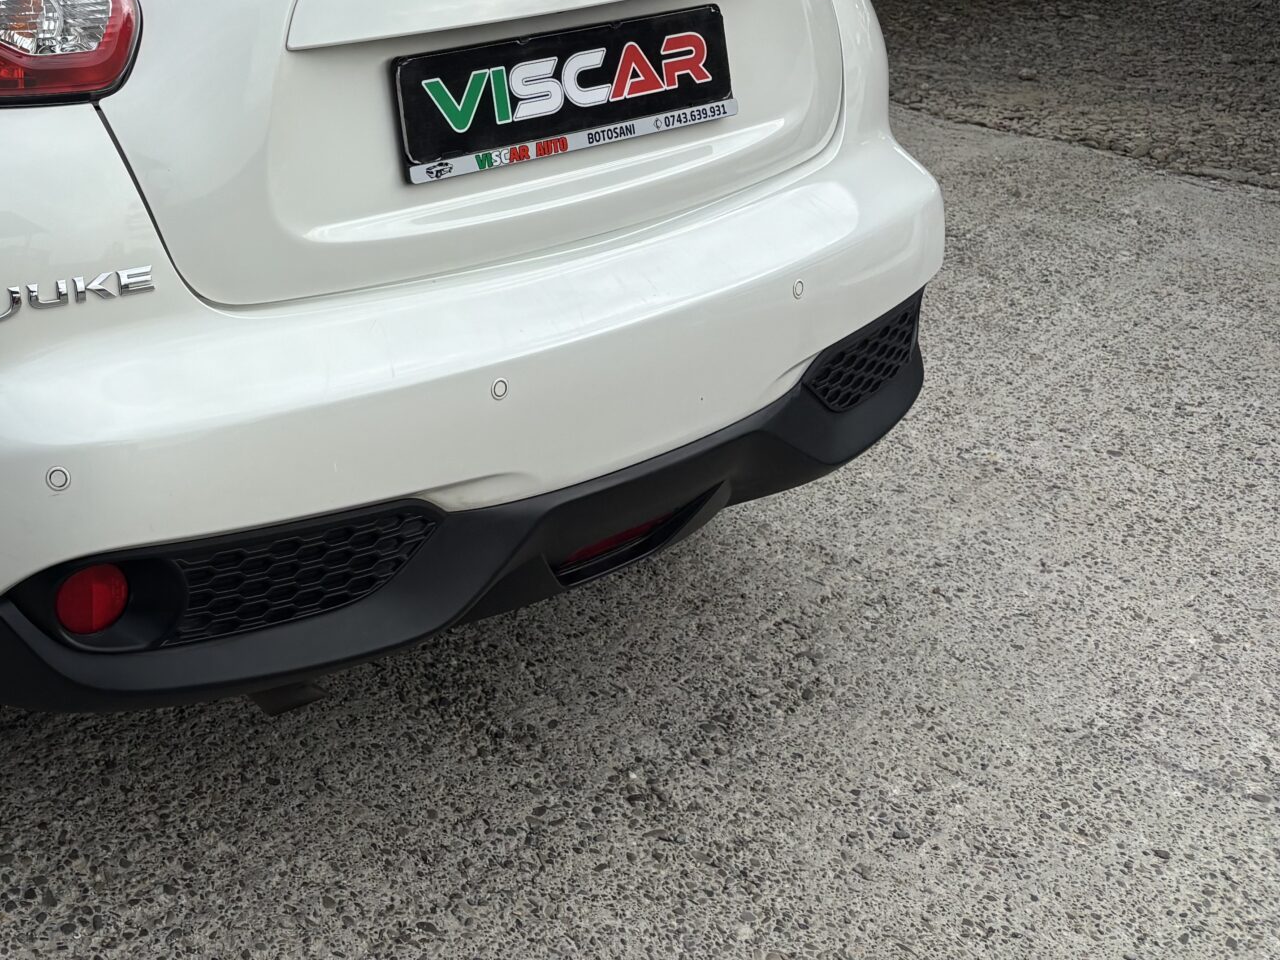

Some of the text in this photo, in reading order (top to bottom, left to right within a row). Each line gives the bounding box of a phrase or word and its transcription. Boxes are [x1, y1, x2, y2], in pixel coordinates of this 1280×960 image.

[421, 31, 713, 133] VISCAR
[474, 104, 728, 170] VISCAR AUTO BOTOSANI 0743.639.931
